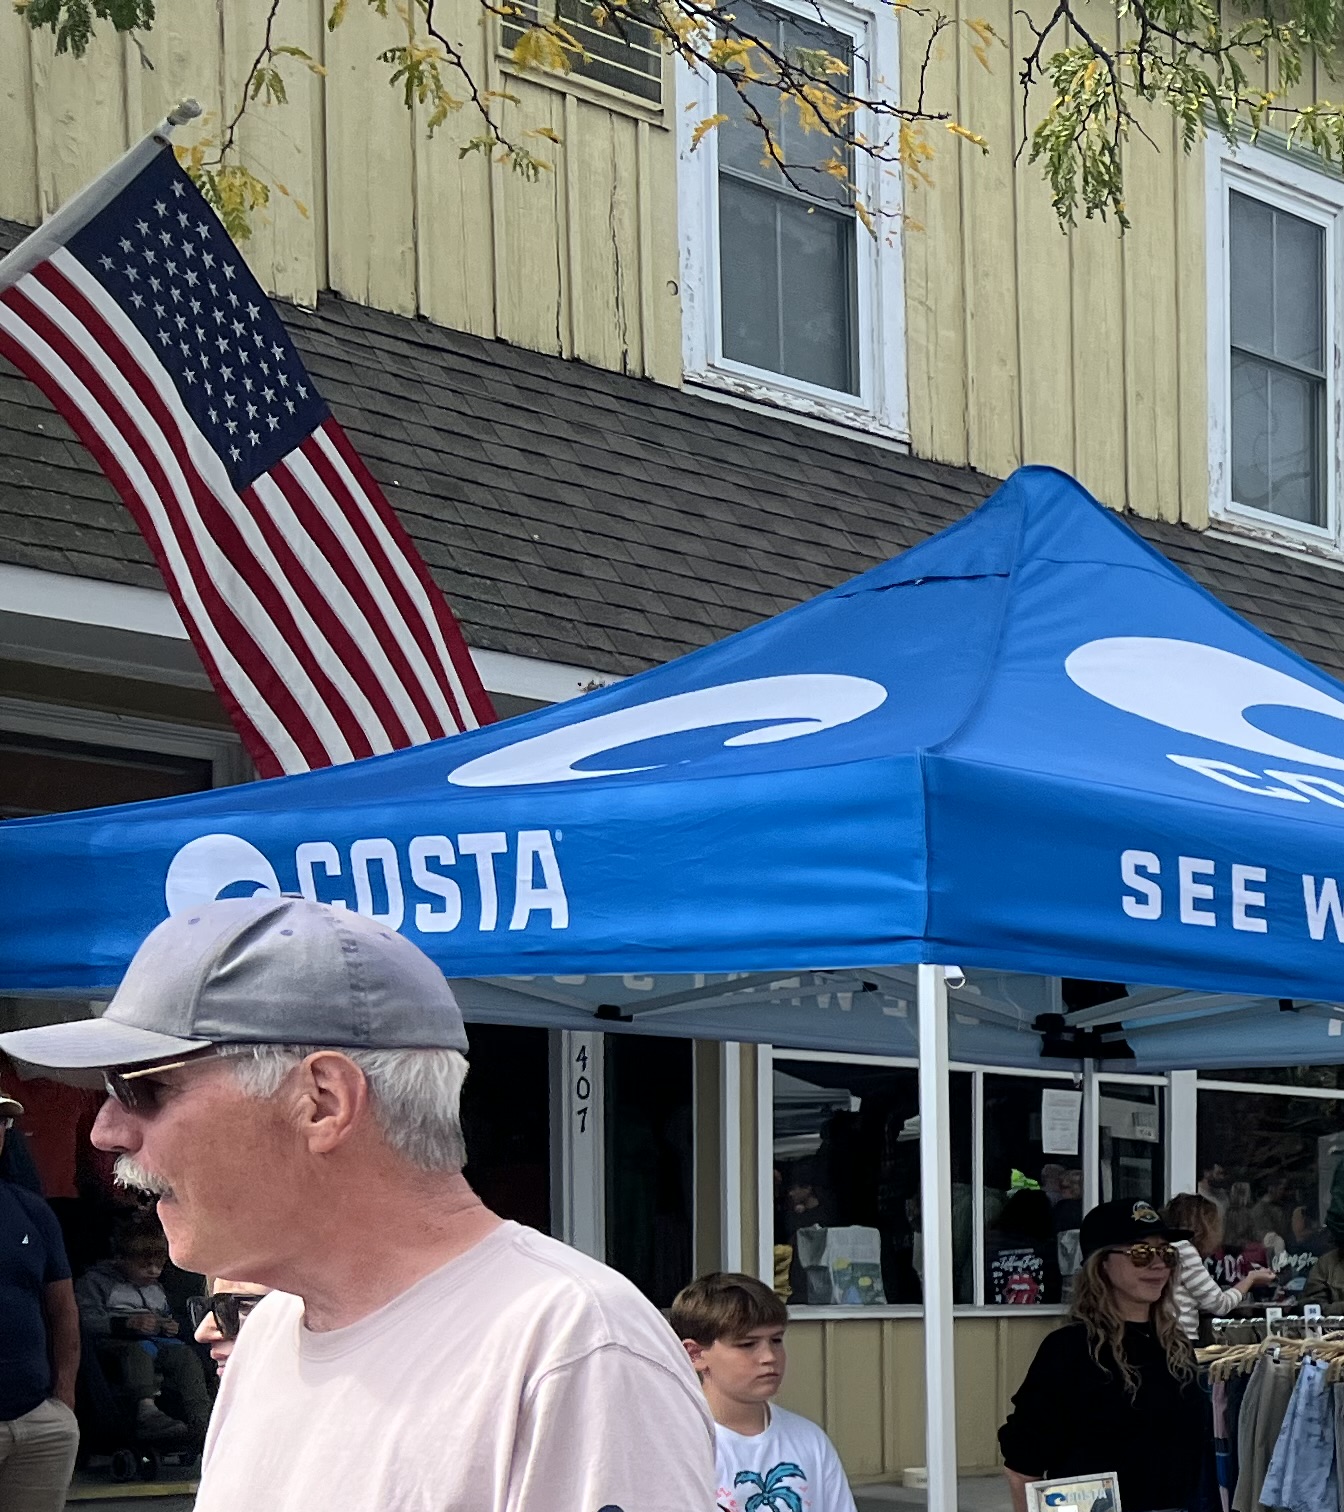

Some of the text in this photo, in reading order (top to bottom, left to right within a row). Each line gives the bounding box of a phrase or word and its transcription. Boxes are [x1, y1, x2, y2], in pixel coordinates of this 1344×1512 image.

[296, 829, 569, 933] COSTA
[1121, 849, 1268, 934] SEE
[576, 1044, 591, 1133] 407
